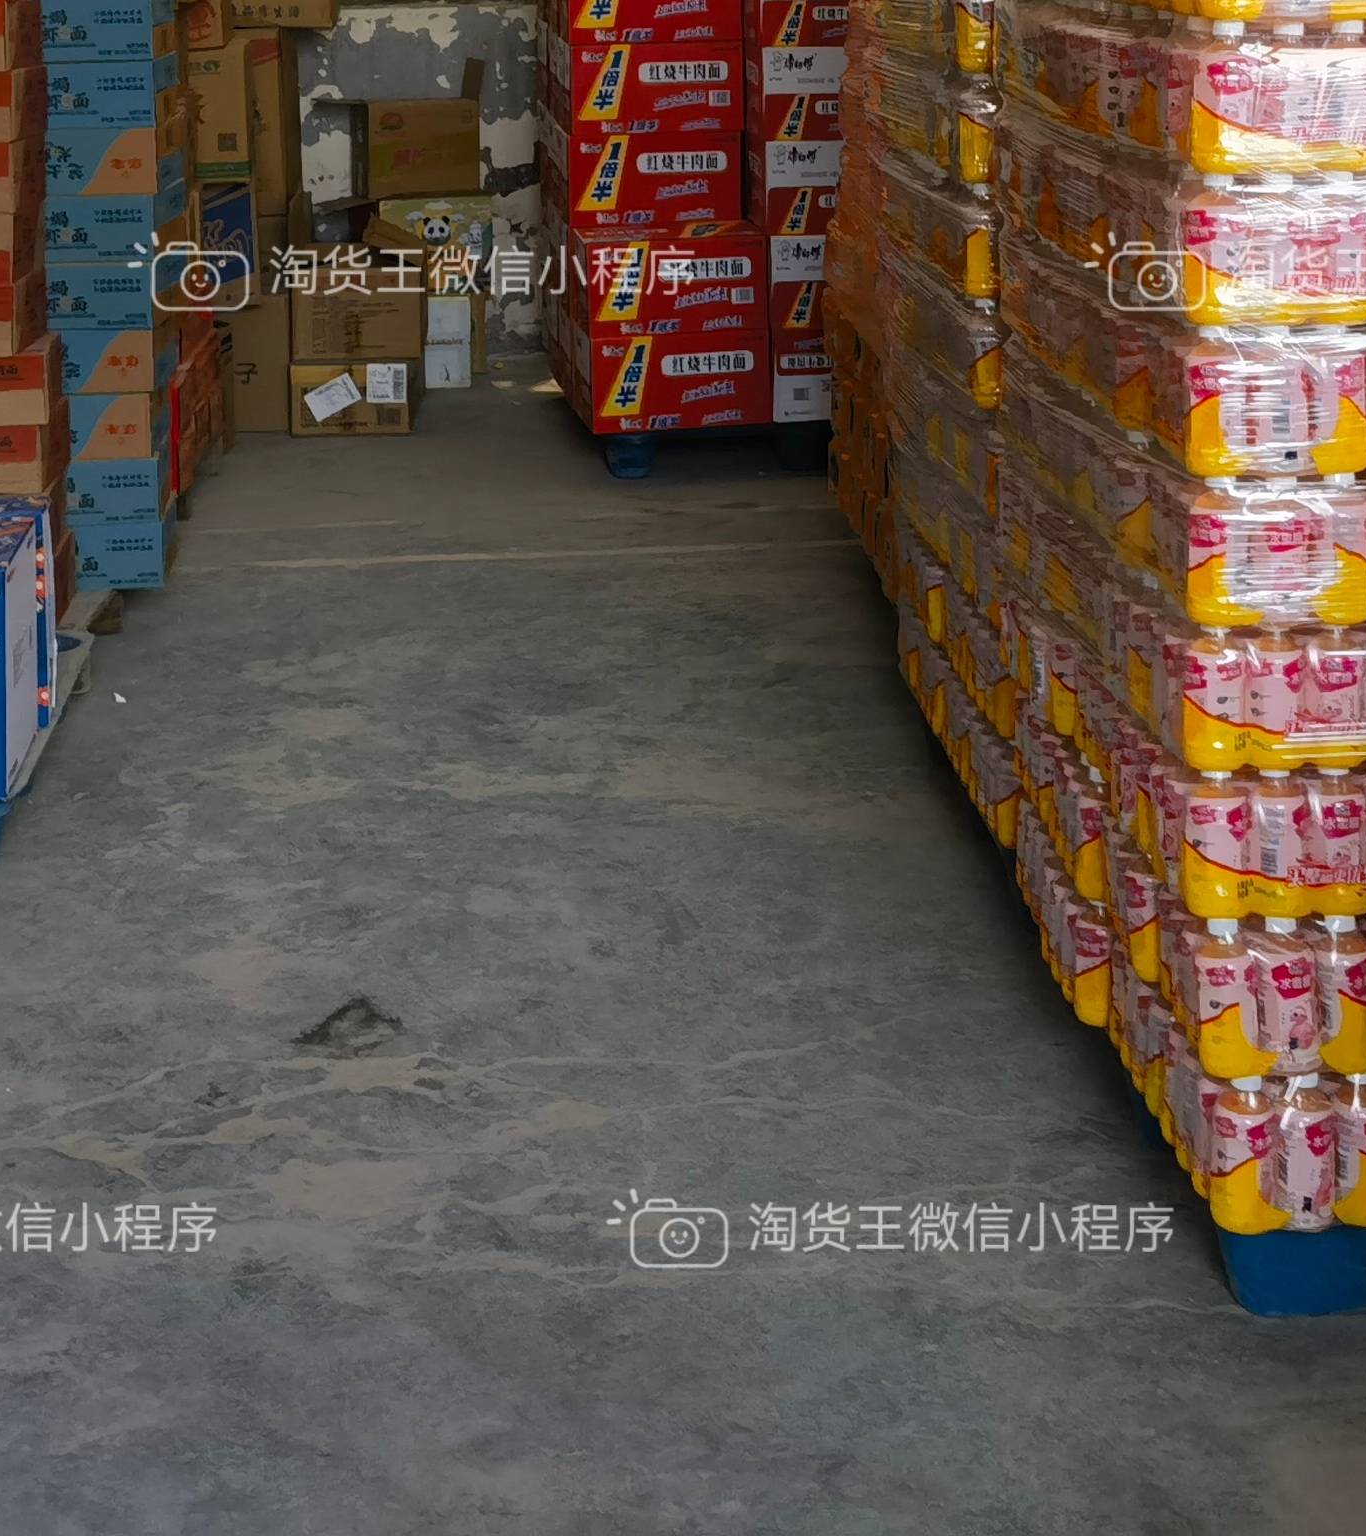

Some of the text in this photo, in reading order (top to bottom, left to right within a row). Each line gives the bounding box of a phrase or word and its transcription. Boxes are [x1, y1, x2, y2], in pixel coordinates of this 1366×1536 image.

[649, 62, 721, 81] 红烧牛肉面
[646, 151, 719, 172] 红烧牛肉面
[672, 352, 746, 373] 红烧牛肉面
